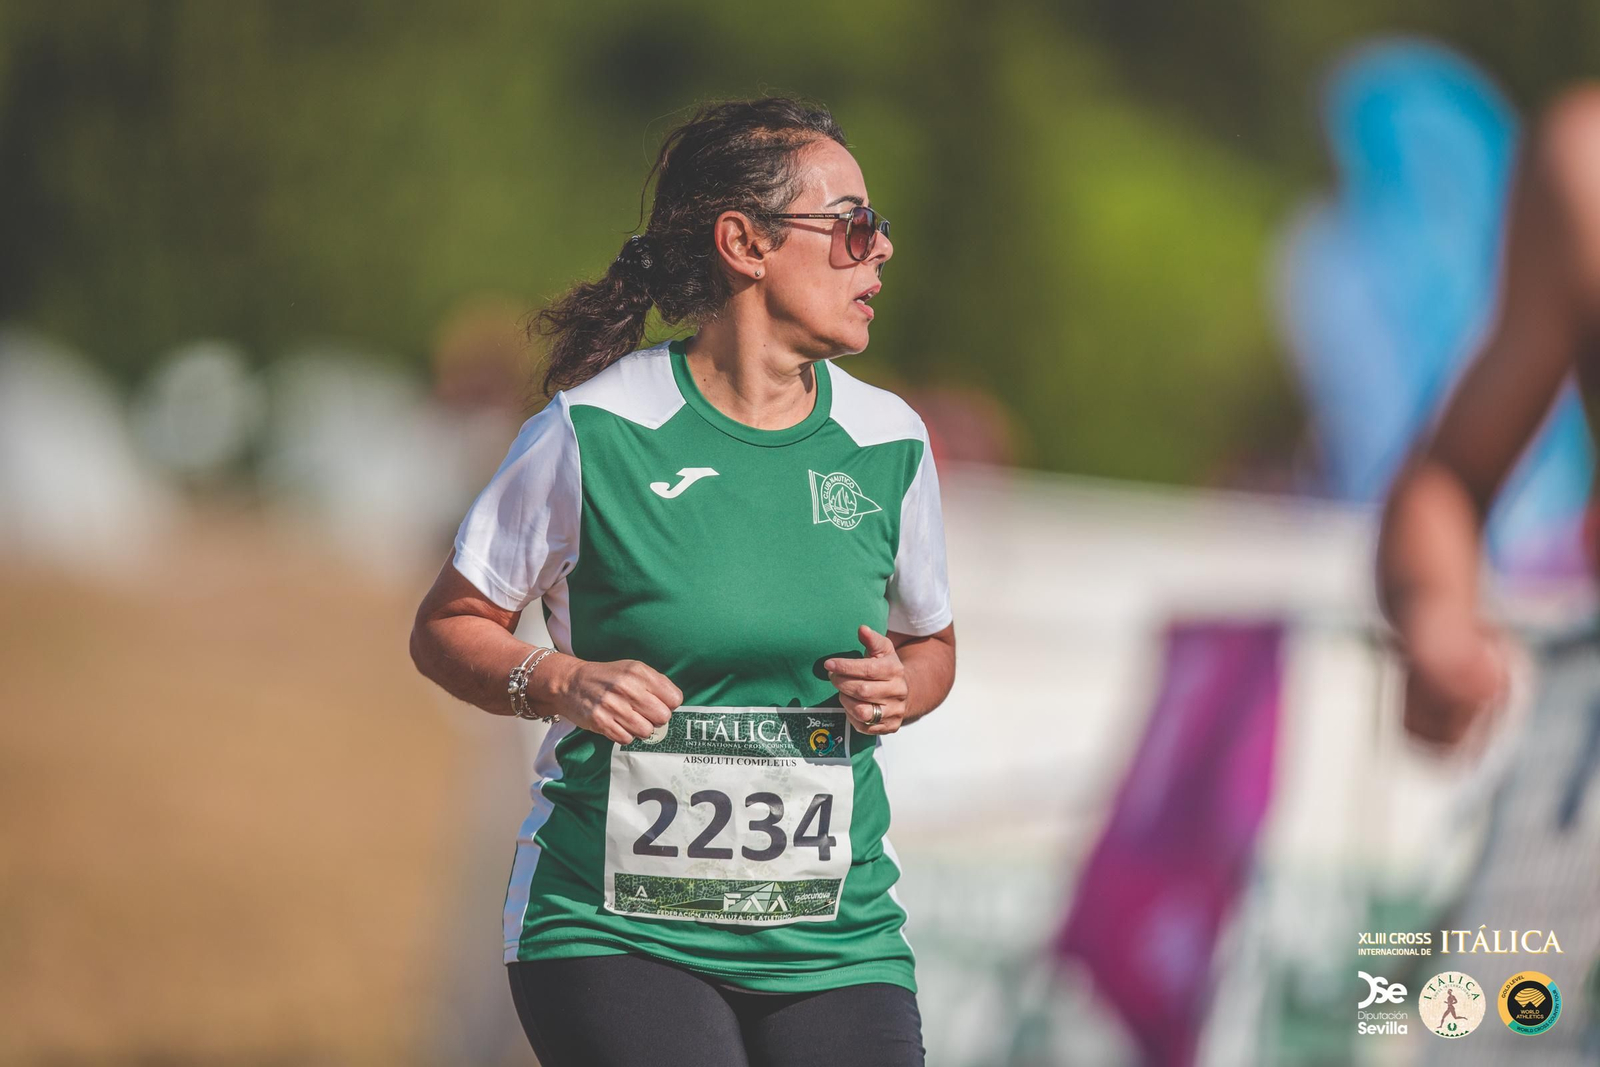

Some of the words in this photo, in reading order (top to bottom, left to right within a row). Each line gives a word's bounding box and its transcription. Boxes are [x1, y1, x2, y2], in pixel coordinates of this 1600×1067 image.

[823, 481, 831, 499] CLUB
[829, 475, 855, 489] NAUTICO
[832, 515, 856, 528] SEVILLA
[685, 715, 793, 743] ITÁLICA
[685, 741, 742, 749] INTERNATIONAL
[683, 756, 735, 766] ABSOLUTI
[736, 757, 798, 768] COMPLETUS
[633, 788, 837, 861] 2234
[656, 909, 701, 918] FEDERACIÓN
[703, 912, 744, 921] ANDALUZA
